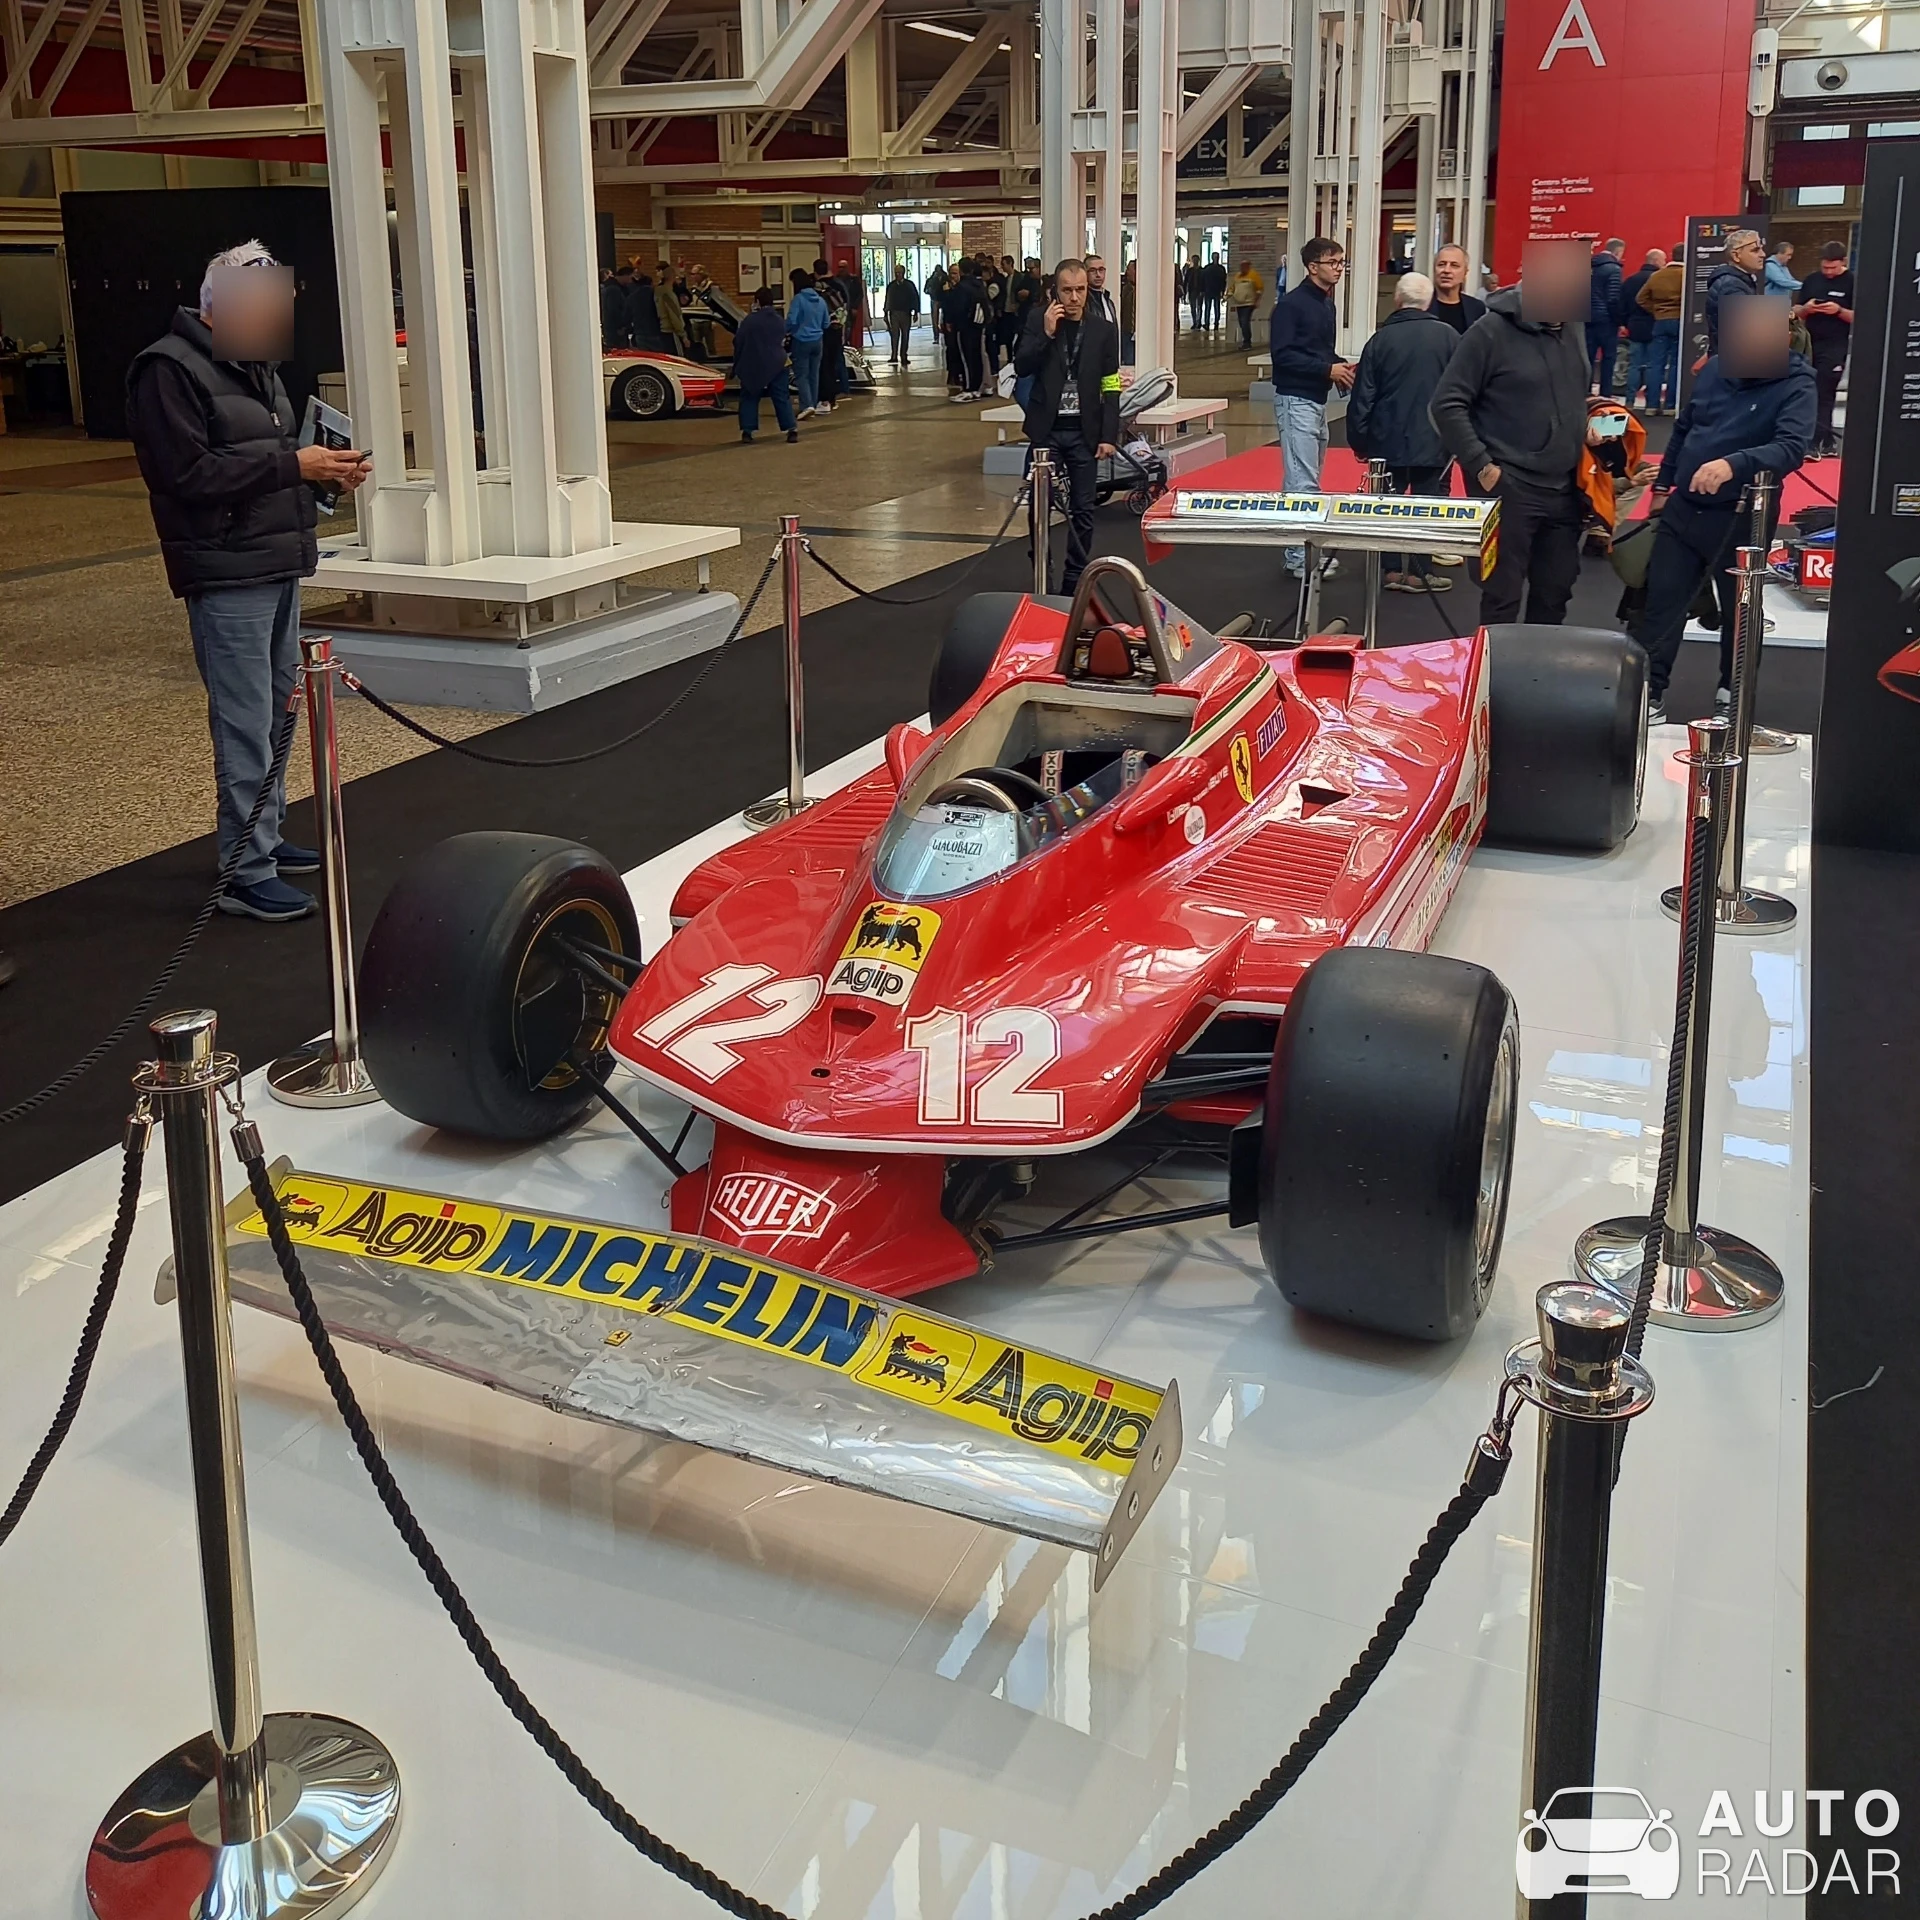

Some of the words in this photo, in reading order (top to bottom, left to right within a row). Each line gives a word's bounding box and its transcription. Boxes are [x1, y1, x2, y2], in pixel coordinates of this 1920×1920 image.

[1538, 0, 1606, 70] A
[1197, 139, 1250, 159] EX
[1191, 497, 1319, 513] MICHELIN
[1338, 502, 1476, 520] MICHELIN
[1258, 706, 1286, 756] FIAT
[932, 839, 983, 856] GIACOBAZZI
[831, 963, 904, 999] Agip
[633, 962, 826, 1085] 12
[904, 1004, 1065, 1129] 12
[718, 1176, 819, 1230] HEUER
[322, 1190, 488, 1265] Agip
[476, 1219, 878, 1368] MICHELIN
[952, 1347, 1154, 1460] Agip
